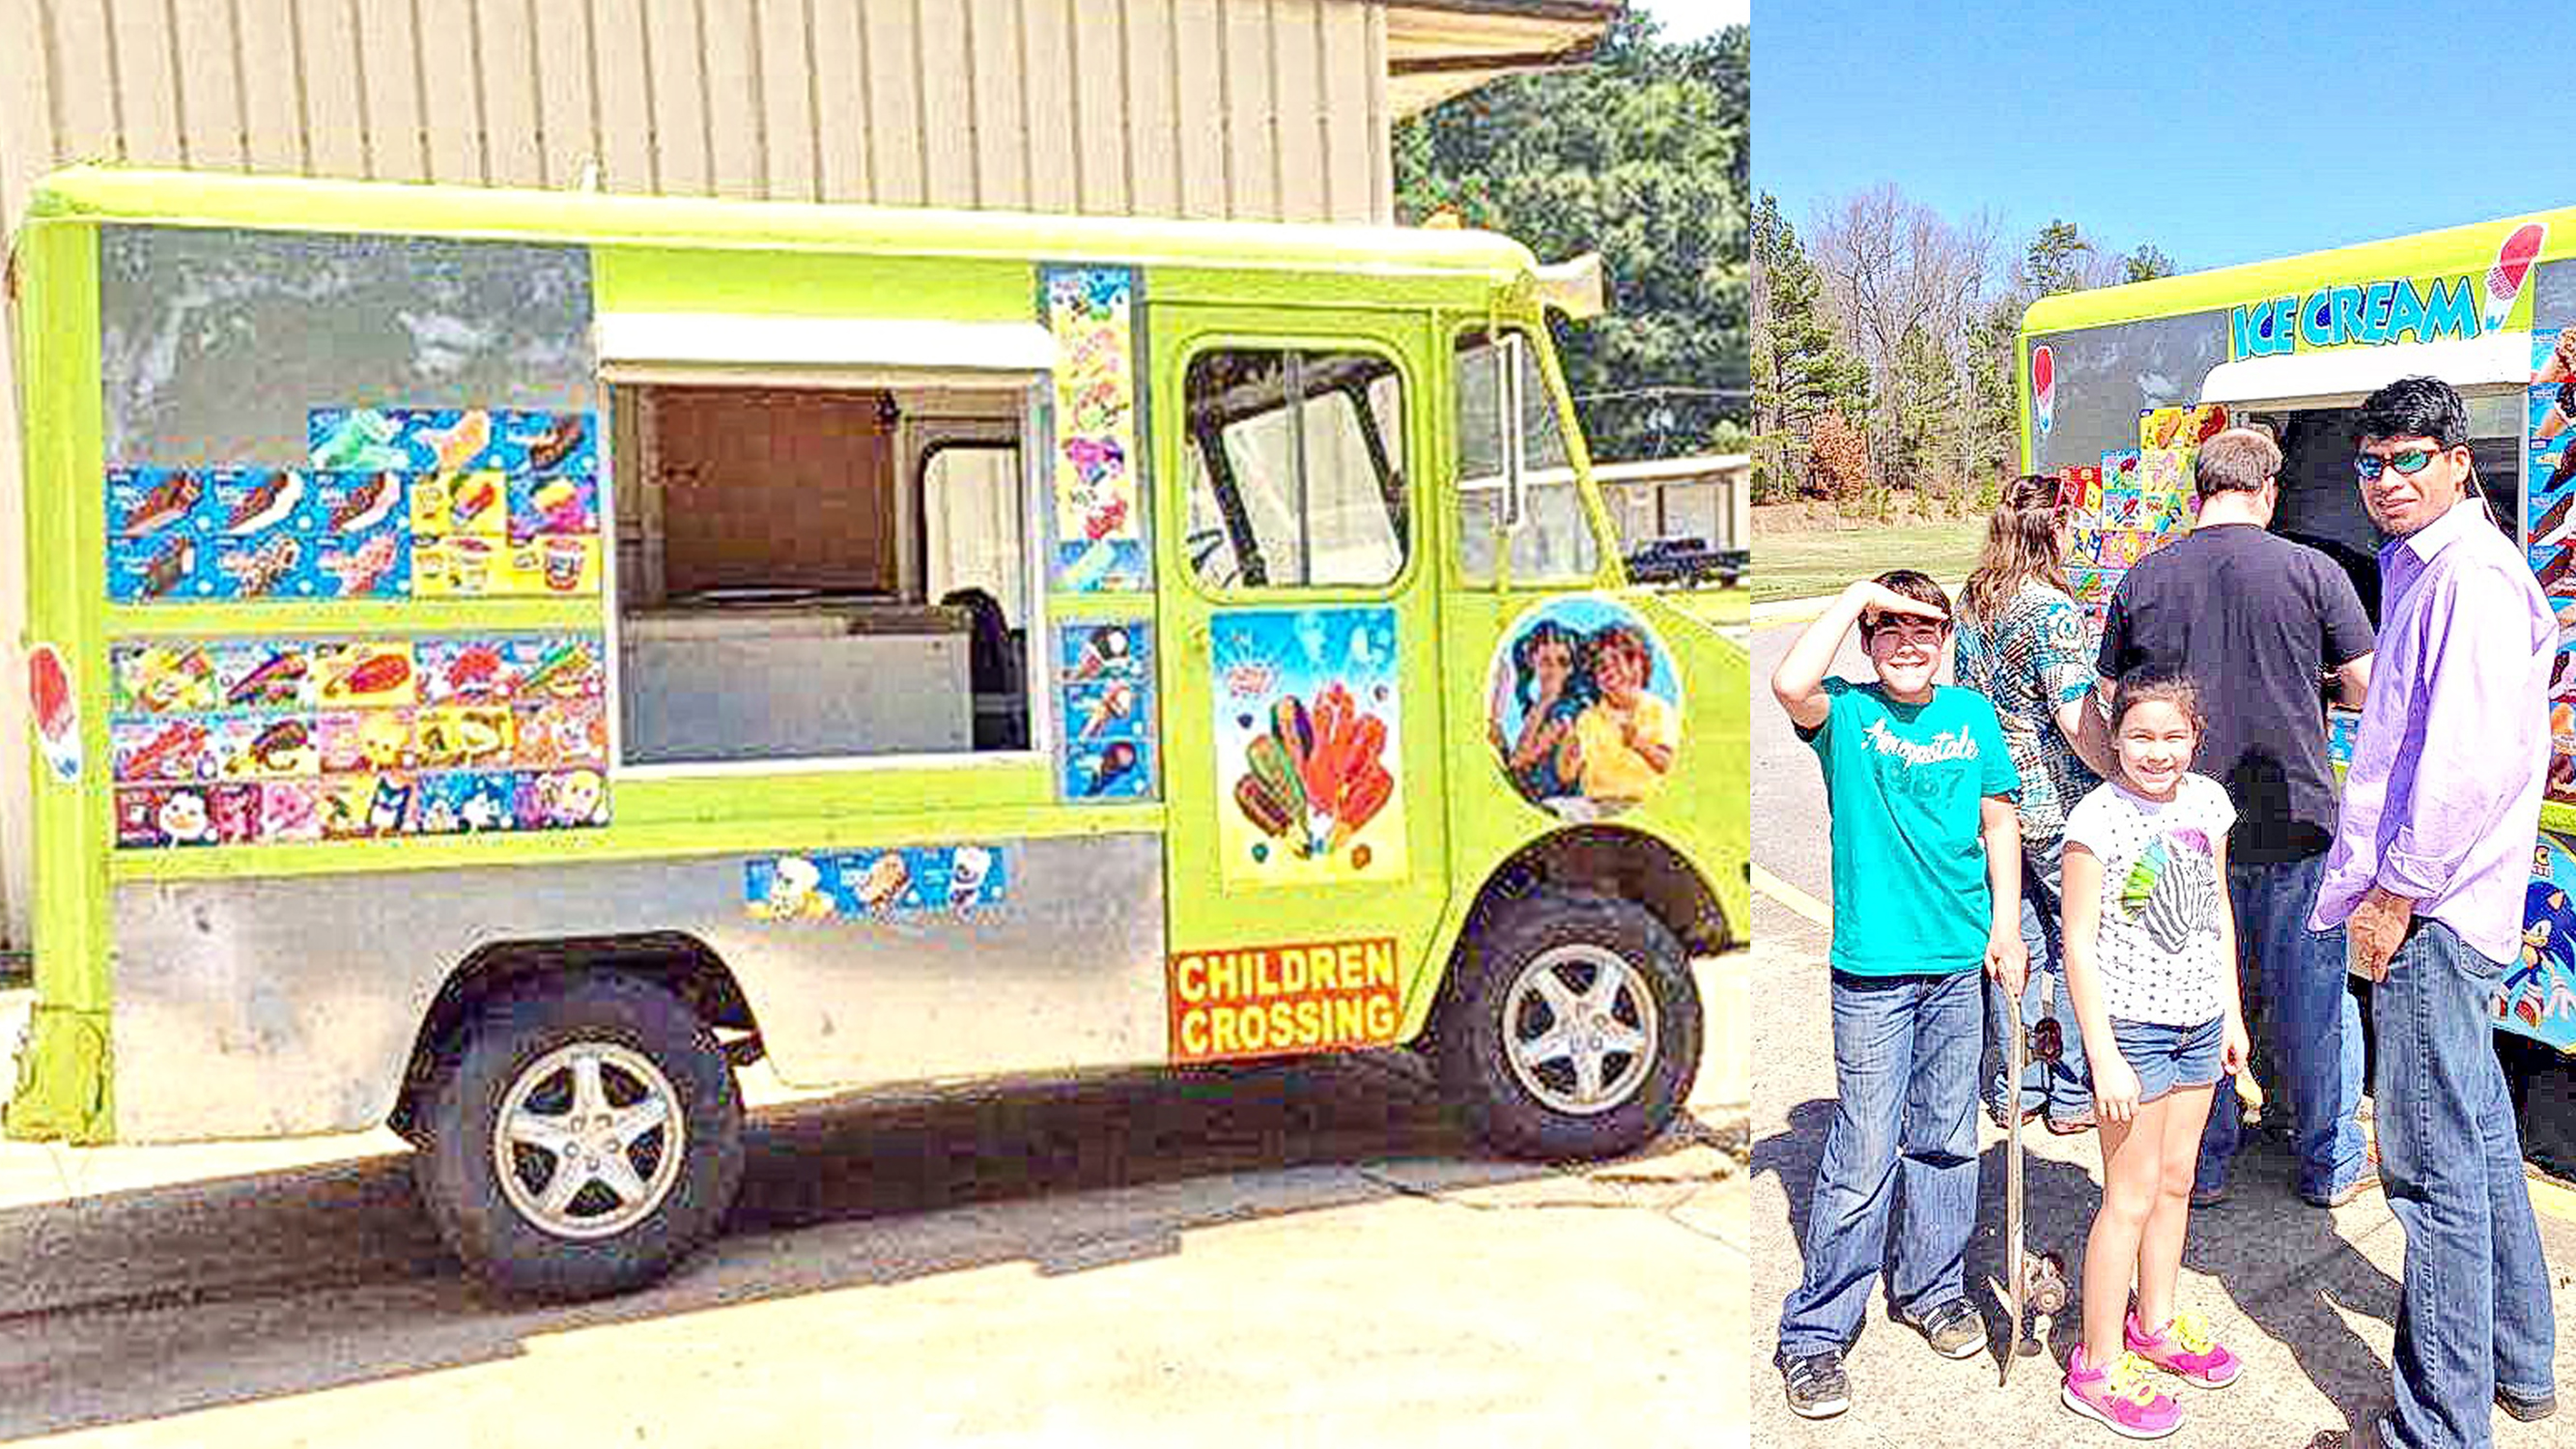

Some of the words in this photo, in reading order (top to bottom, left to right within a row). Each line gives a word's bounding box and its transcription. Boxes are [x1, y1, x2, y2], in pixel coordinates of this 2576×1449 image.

[2231, 295, 2300, 363] ICE
[2300, 275, 2481, 349] CREAM
[1178, 941, 1394, 1003] CHILDREN
[1181, 995, 1396, 1054] CROSSING
